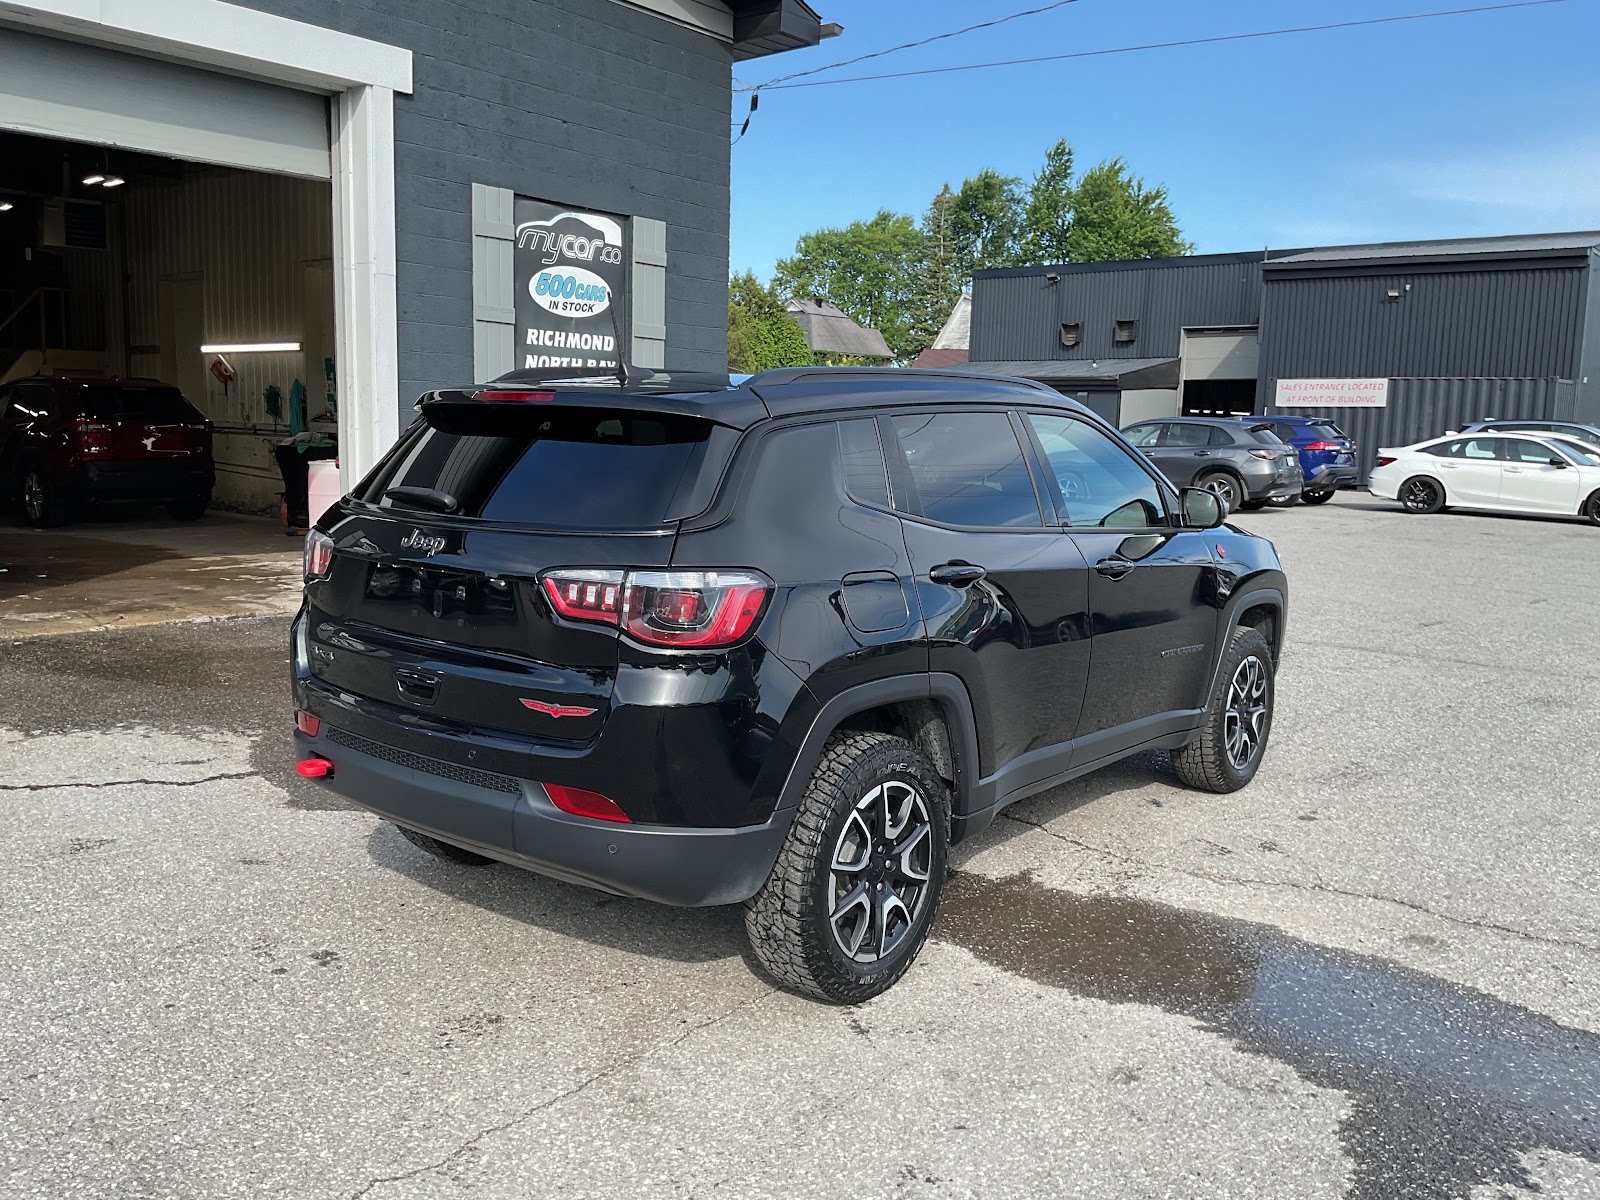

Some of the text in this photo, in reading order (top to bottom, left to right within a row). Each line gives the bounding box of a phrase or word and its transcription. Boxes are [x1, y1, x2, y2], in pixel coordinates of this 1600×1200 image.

[548, 300, 596, 313] IN STOCK
[526, 328, 614, 351] RICHMOND
[524, 354, 583, 369] NORTH
[1280, 383, 1384, 391] SALES ENTRANCE LOCATED
[1286, 395, 1376, 403] AT FRONT OF BUILDING
[400, 528, 446, 558] Jeep
